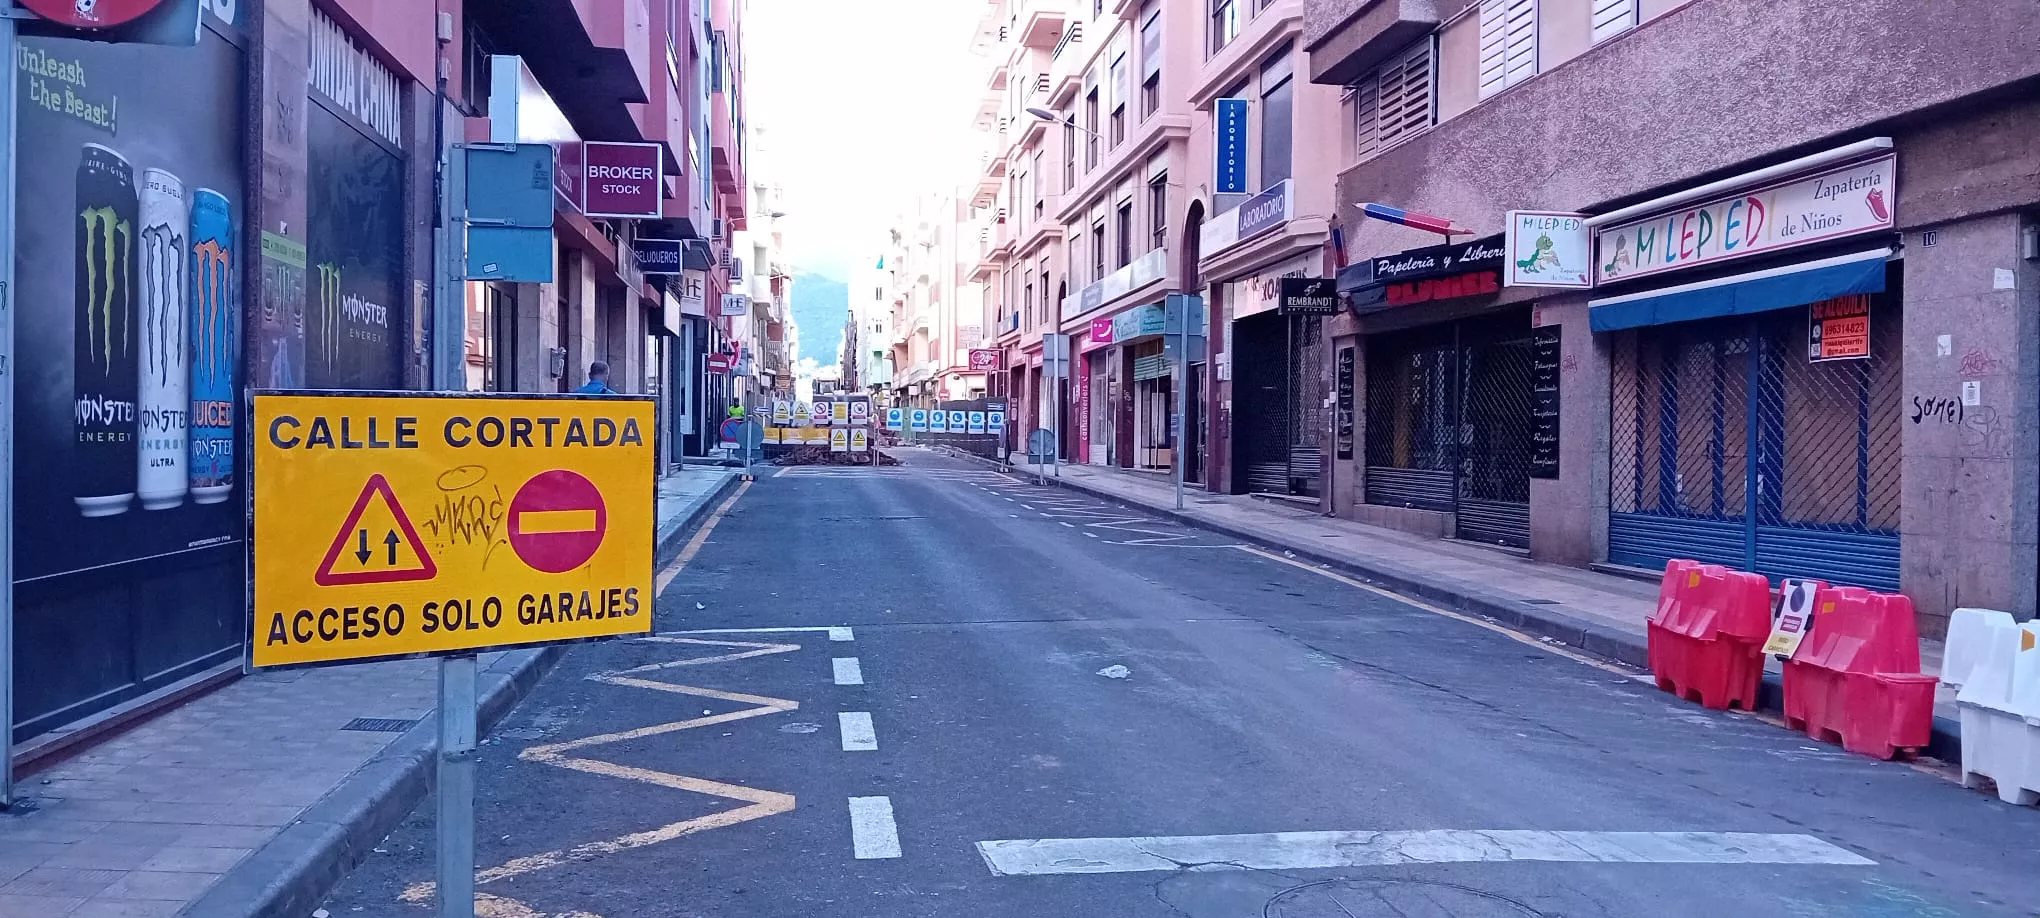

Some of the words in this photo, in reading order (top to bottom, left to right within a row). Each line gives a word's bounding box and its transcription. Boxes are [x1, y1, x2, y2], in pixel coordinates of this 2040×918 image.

[17, 42, 86, 87] Unleash
[30, 76, 60, 112] the
[65, 86, 118, 132] Beast!
[361, 48, 401, 149] CHINA
[589, 165, 653, 180] BROKER
[1814, 170, 1881, 200] Zapatería
[602, 184, 641, 195] STOCK
[1239, 194, 1285, 232] LABORATORIO
[1781, 216, 1797, 238] de
[1801, 210, 1842, 233] Niños
[1924, 232, 1936, 246] 10
[1378, 256, 1435, 276] Papelería
[1444, 256, 1452, 268] y
[342, 293, 388, 328] MONSTER
[1287, 296, 1333, 308] REMBRANDT
[350, 328, 380, 343] ENERGY
[74, 394, 134, 426] MONSTE
[80, 432, 131, 442] ENERGY
[140, 440, 184, 450] ENERGY
[269, 415, 419, 450] CALLE
[443, 415, 643, 448] CORTADA
[150, 458, 174, 468] ULTRA
[266, 603, 405, 647] ACCESO
[421, 596, 502, 633] SOLO
[517, 587, 640, 625] GARAJES
